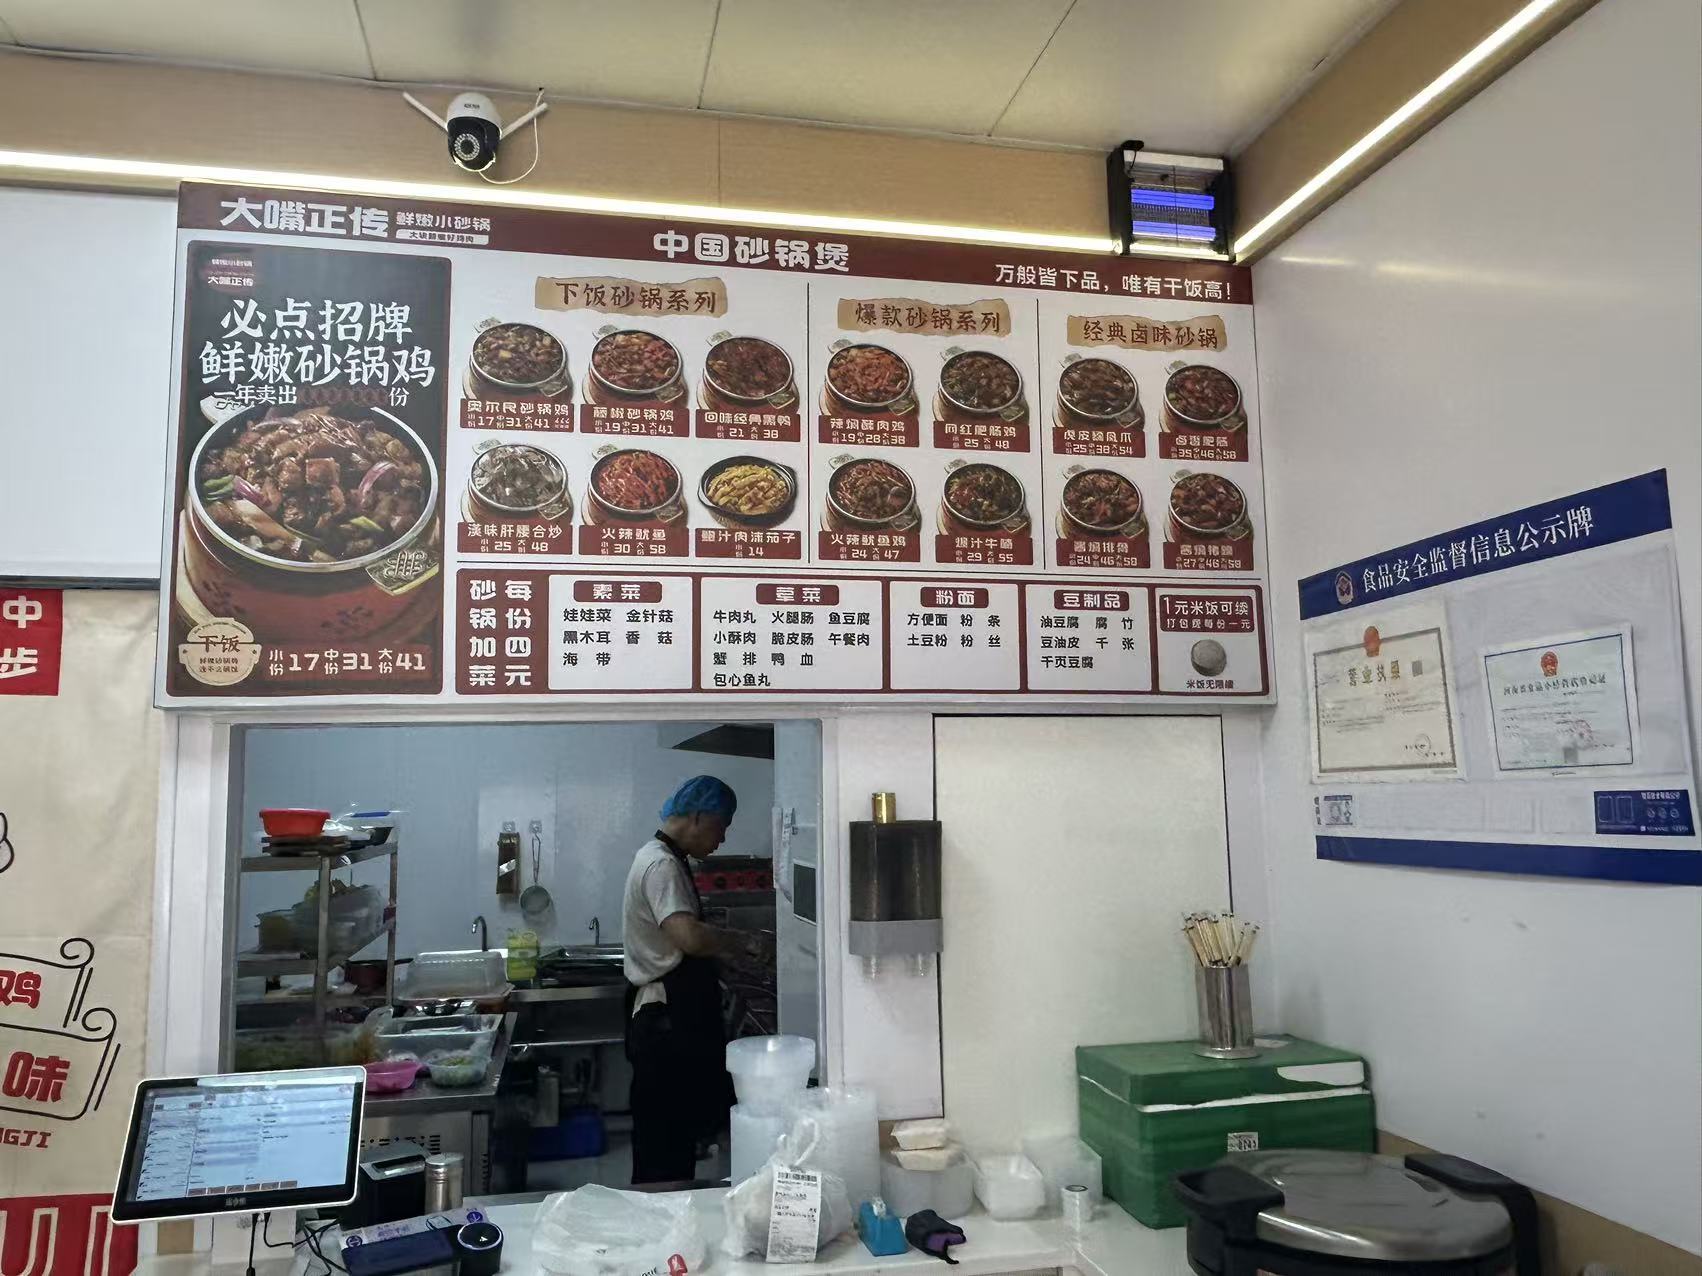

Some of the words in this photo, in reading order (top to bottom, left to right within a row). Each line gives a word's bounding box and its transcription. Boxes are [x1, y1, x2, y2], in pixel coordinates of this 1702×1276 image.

[220, 197, 388, 238] 大嘴正传
[396, 211, 491, 232] 鲜嫩小砂锅
[652, 231, 850, 272] 中国砂锅煲
[556, 282, 716, 314] 下饭砂锅系列
[220, 298, 413, 344] 必点招牌
[855, 302, 1001, 335] 爆款砂锅系列
[1083, 320, 1219, 349] 经典卤味砂锅
[199, 341, 436, 388] 鲜嫩砂锅鸡
[213, 385, 298, 405] 一年卖出
[389, 387, 410, 407] 份
[478, 416, 494, 426] 17
[506, 417, 522, 427] 31
[534, 419, 550, 428] 41
[605, 422, 621, 432] 19
[631, 424, 647, 433] 31
[658, 425, 674, 434] 41
[729, 428, 744, 437] 21
[763, 430, 778, 438] 38
[841, 433, 855, 442] 19
[866, 434, 881, 443] 28
[891, 436, 905, 444] 38
[965, 439, 978, 447] 25
[1073, 444, 1087, 453] 25
[1096, 445, 1110, 453] 38
[1178, 449, 1192, 457] 35
[1201, 450, 1214, 458] 46
[1223, 451, 1236, 459] 58
[602, 528, 666, 540] 火辣鱿鱼
[831, 533, 906, 546] 火辣鱿鱼鸡
[494, 541, 511, 550] 25
[532, 542, 548, 552] 48
[614, 543, 630, 553] 30
[650, 545, 666, 554] 58
[748, 547, 764, 556] 14
[852, 549, 867, 558] 24
[884, 550, 899, 559] 47
[1361, 505, 1594, 594] 食品安全监督信息公示牌
[967, 552, 982, 561] 29
[999, 554, 1013, 562] 55
[593, 583, 641, 600] 素菜
[775, 586, 821, 603] 荤菜
[935, 589, 975, 605] 粉面
[1063, 592, 1121, 609] 豆制品
[1163, 596, 1249, 616] 1元米饭可续
[3, 595, 43, 629] 中
[563, 608, 612, 623] 娃娃菜
[626, 608, 673, 624] 金针菇
[713, 610, 757, 625] 牛肉丸
[771, 610, 814, 625] 火腿肠
[828, 612, 870, 626] 鱼豆腐
[907, 613, 948, 627] 方便面
[960, 614, 1001, 628] 粉条
[1040, 615, 1079, 630] 油豆腐
[1095, 616, 1134, 631] 腐竹
[469, 579, 496, 686] 砂锅加菜
[504, 580, 532, 686] 每份四元
[563, 630, 611, 645] 黑木耳
[625, 630, 673, 645] 香菇
[713, 631, 757, 645] 小酥肉
[771, 632, 814, 646] 脆皮肠
[828, 632, 870, 647] 午餐肉
[198, 634, 241, 653] 下饭
[907, 634, 948, 648] 土豆粉
[960, 634, 1001, 648] 粉丝
[1040, 636, 1080, 650] 豆油皮
[1095, 637, 1135, 651] 千张
[289, 654, 320, 671] 17
[343, 653, 373, 670] 31
[396, 653, 426, 670] 41
[563, 652, 611, 667] 海带
[713, 652, 757, 666] 蟹排
[771, 652, 814, 666] 鸭血
[1040, 655, 1094, 669] 千页豆腐
[713, 673, 771, 687] 包心鱼丸
[2, 1051, 70, 1103] 味
